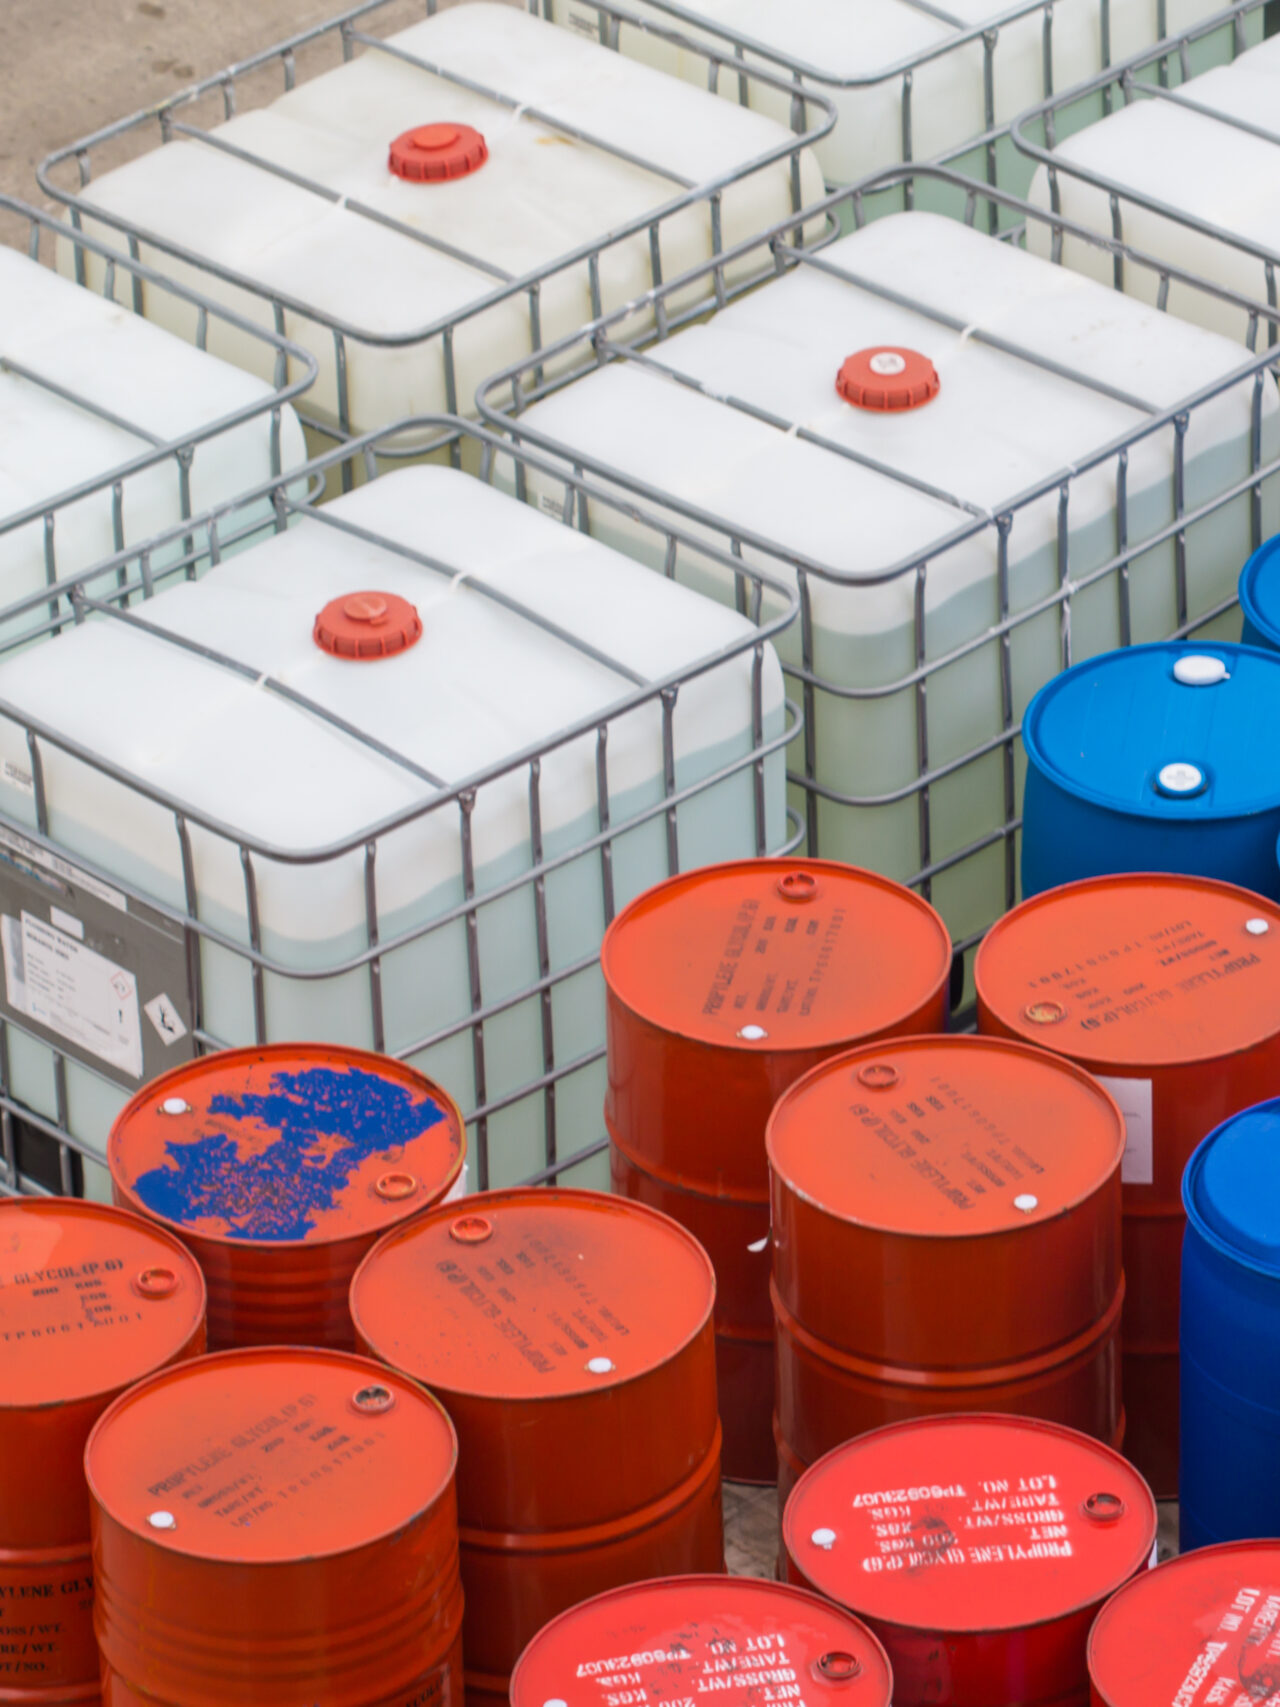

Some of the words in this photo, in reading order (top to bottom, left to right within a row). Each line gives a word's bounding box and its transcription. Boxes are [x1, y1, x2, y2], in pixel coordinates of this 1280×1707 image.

[1019, 1475, 1057, 1491] LOT
[970, 1541, 1072, 1562] PROPYLENE
[747, 1633, 785, 1651] LOT
